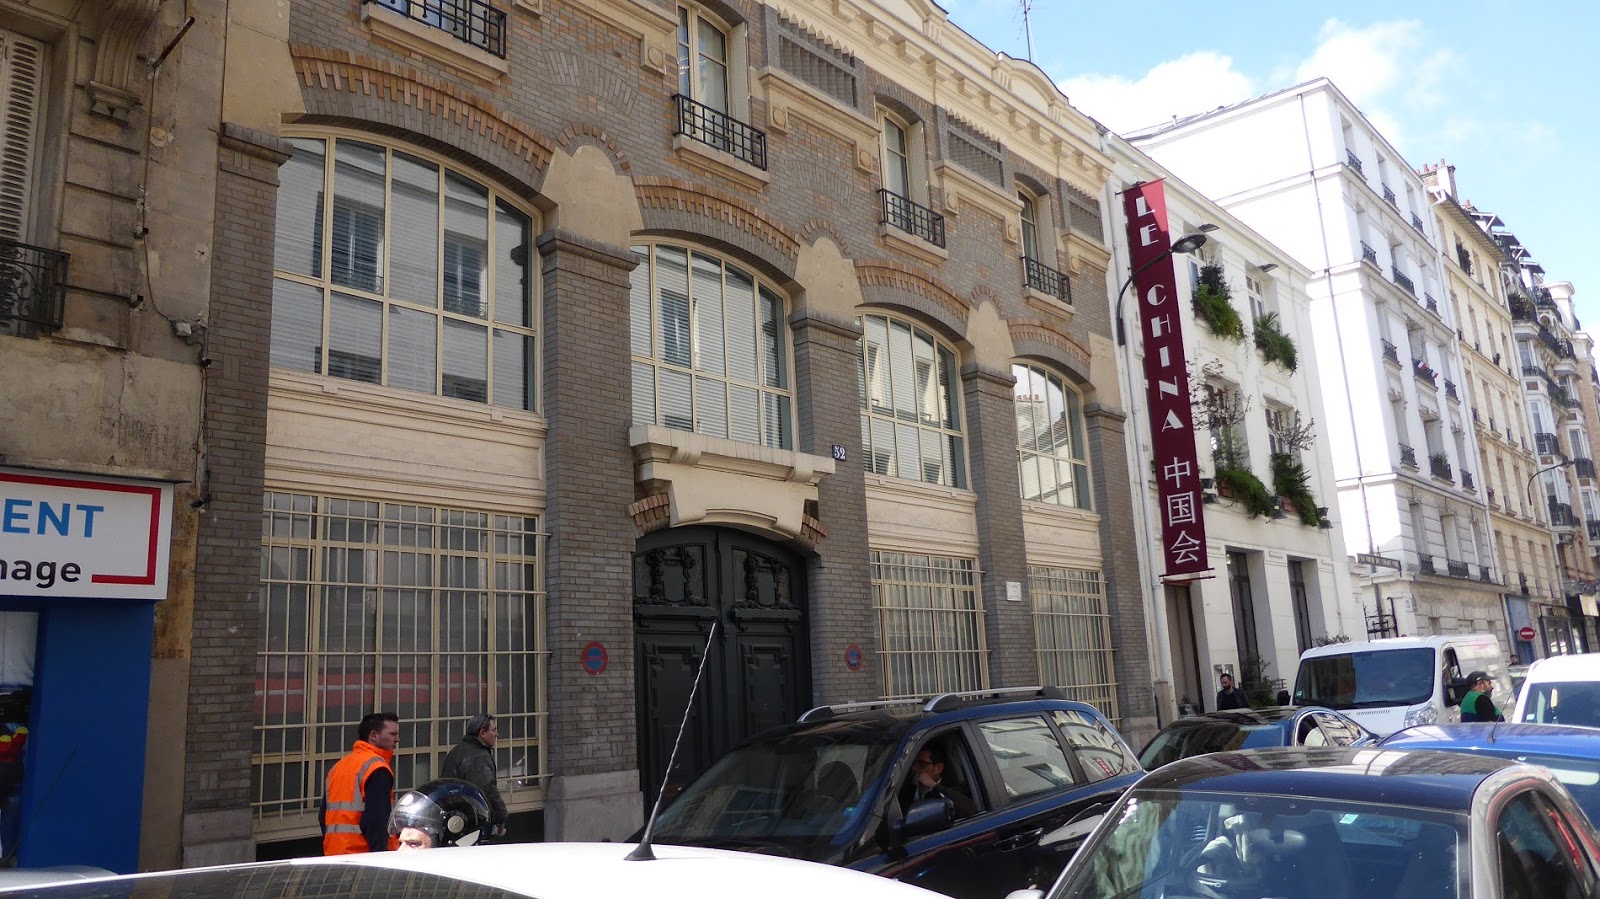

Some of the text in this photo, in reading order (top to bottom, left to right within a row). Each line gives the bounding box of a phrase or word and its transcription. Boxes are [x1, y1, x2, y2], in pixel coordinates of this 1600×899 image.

[1135, 195, 1184, 433] LE CHINA
[834, 445, 846, 460] 52
[2, 498, 104, 538] ENT
[1163, 456, 1201, 566] 中国会
